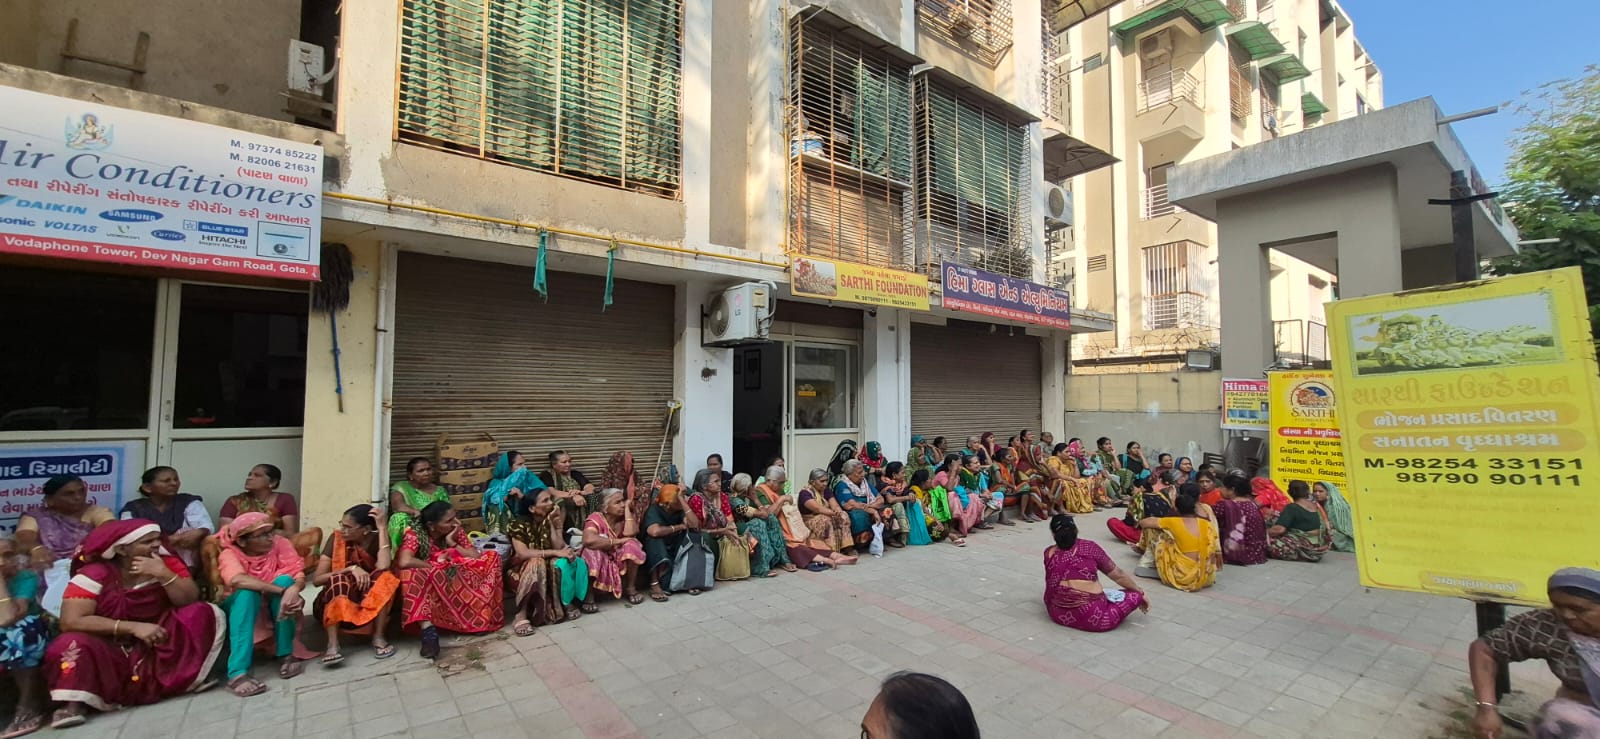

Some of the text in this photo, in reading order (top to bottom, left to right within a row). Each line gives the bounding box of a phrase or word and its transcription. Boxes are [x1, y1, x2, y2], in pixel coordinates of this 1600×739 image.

[231, 140, 318, 161] M. 97374 85222
[230, 152, 316, 174] M. 82006 21631
[65, 153, 317, 209] Conditioners
[7, 178, 39, 190] તથા
[265, 211, 311, 225] આપનાર
[16, 199, 88, 215] DAIKIN
[108, 209, 157, 222] SAMSUNG
[44, 220, 98, 233] VOLTAS
[201, 223, 246, 234] BLUE STAR
[201, 234, 246, 245] HITACHI
[4, 236, 308, 275] Vodaphone Tower, Dev Nagar Gam Road, Gota.
[840, 274, 873, 291] SARTHI
[876, 279, 928, 298] FOUNDATION
[946, 266, 969, 294] હિમા
[972, 277, 997, 299] ગ્લાસ
[998, 277, 1019, 303] એન્ડ
[1224, 382, 1258, 391] Hima
[1291, 407, 1335, 417] SARTHI
[1374, 410, 1427, 426] ભોજન
[1373, 435, 1450, 448] સનાતન
[1364, 457, 1583, 470] M-98254 33151
[1396, 472, 1581, 486] 98790 90111
[2, 500, 24, 513] લેવા
